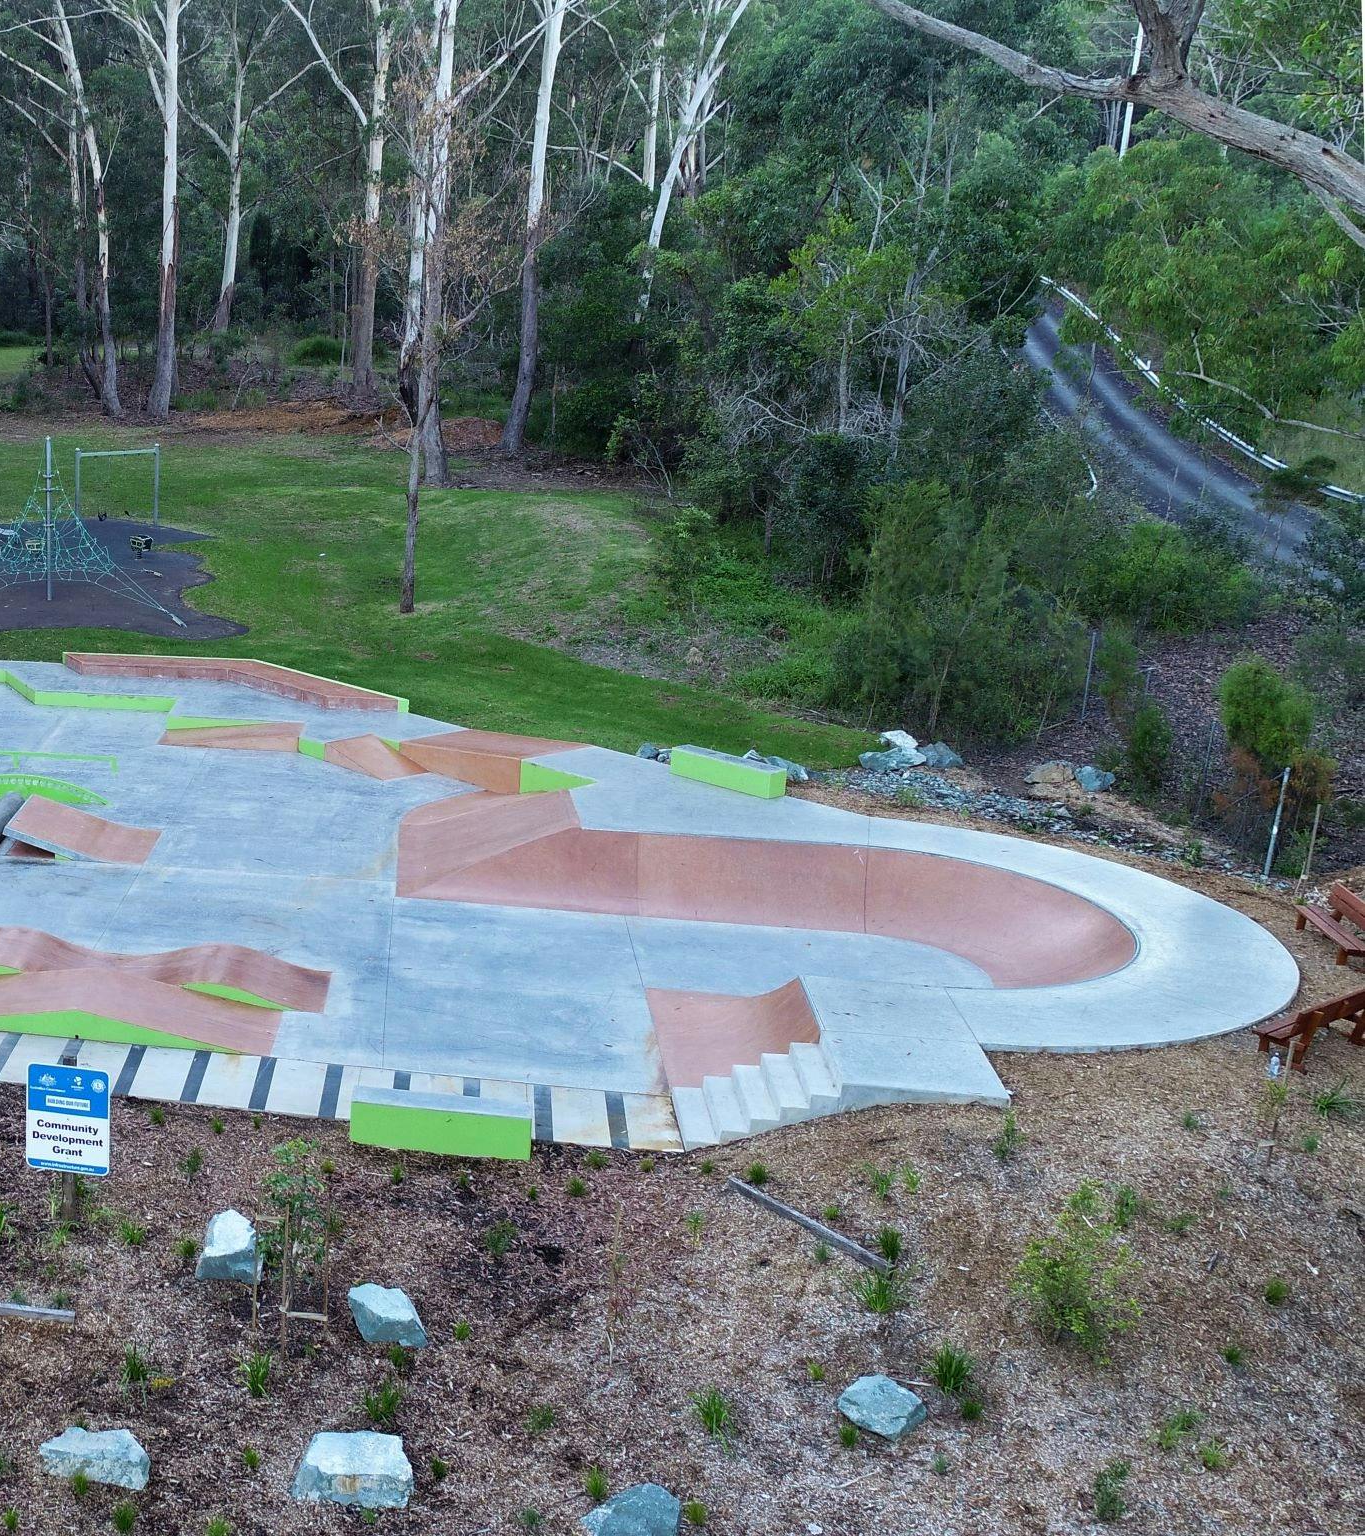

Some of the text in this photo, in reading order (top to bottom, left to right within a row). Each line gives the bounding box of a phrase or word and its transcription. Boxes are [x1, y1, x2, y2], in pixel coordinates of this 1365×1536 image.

[37, 1119, 98, 1136] Community
[32, 1130, 103, 1147] Development
[52, 1145, 83, 1157] Grant
